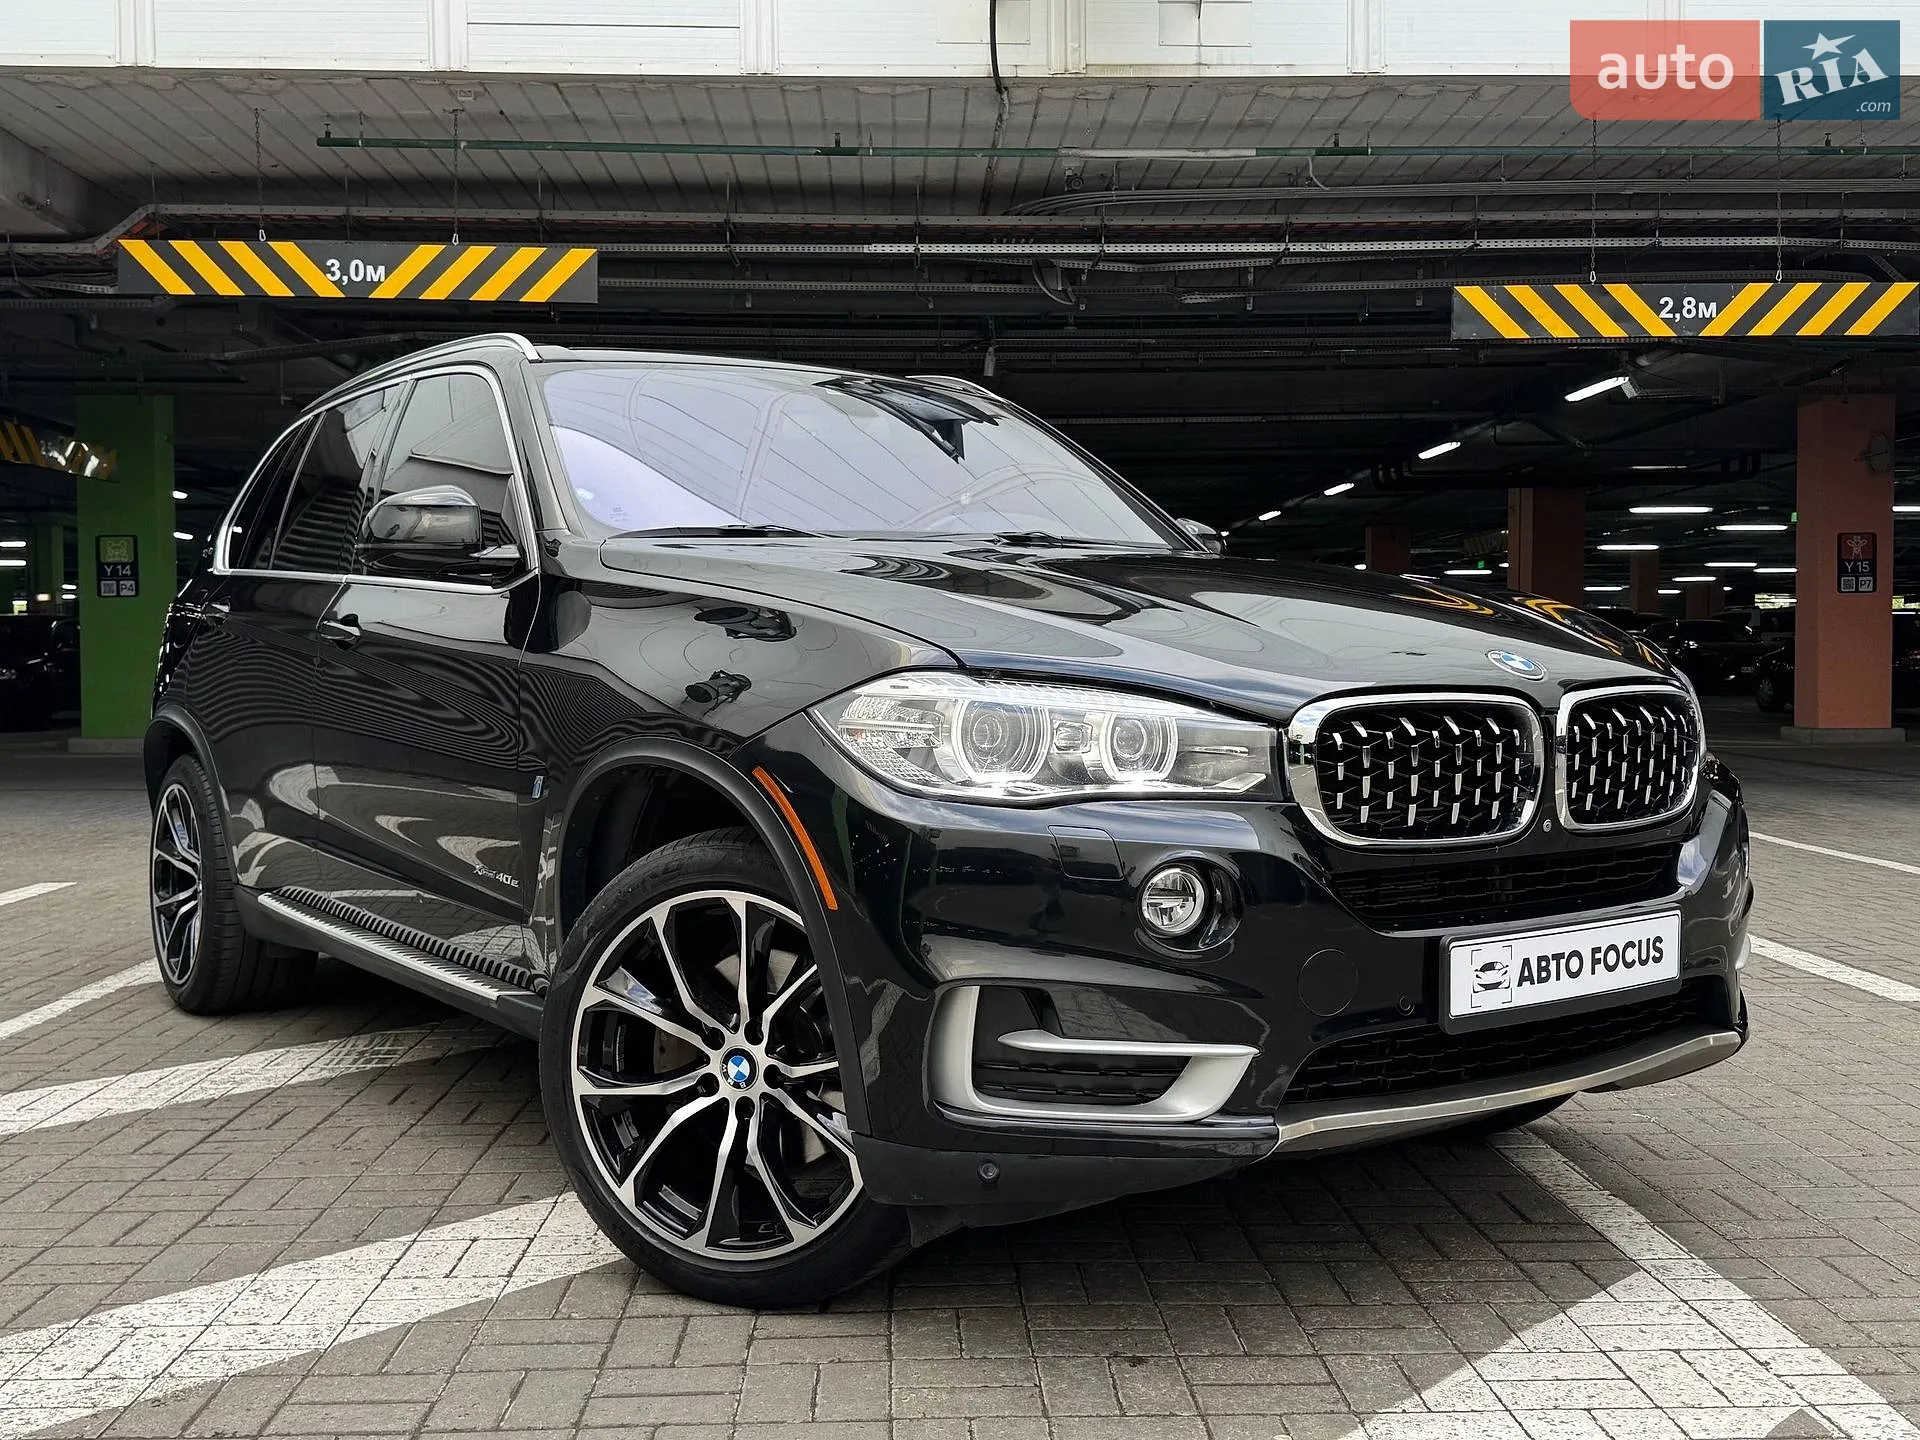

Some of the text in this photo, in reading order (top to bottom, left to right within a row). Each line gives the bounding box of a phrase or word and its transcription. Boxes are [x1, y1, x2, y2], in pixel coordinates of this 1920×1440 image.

[103, 564, 132, 577] Y 14
[1844, 561, 1871, 573] Y 15
[1516, 935, 1664, 988] АВТО FOCUS
